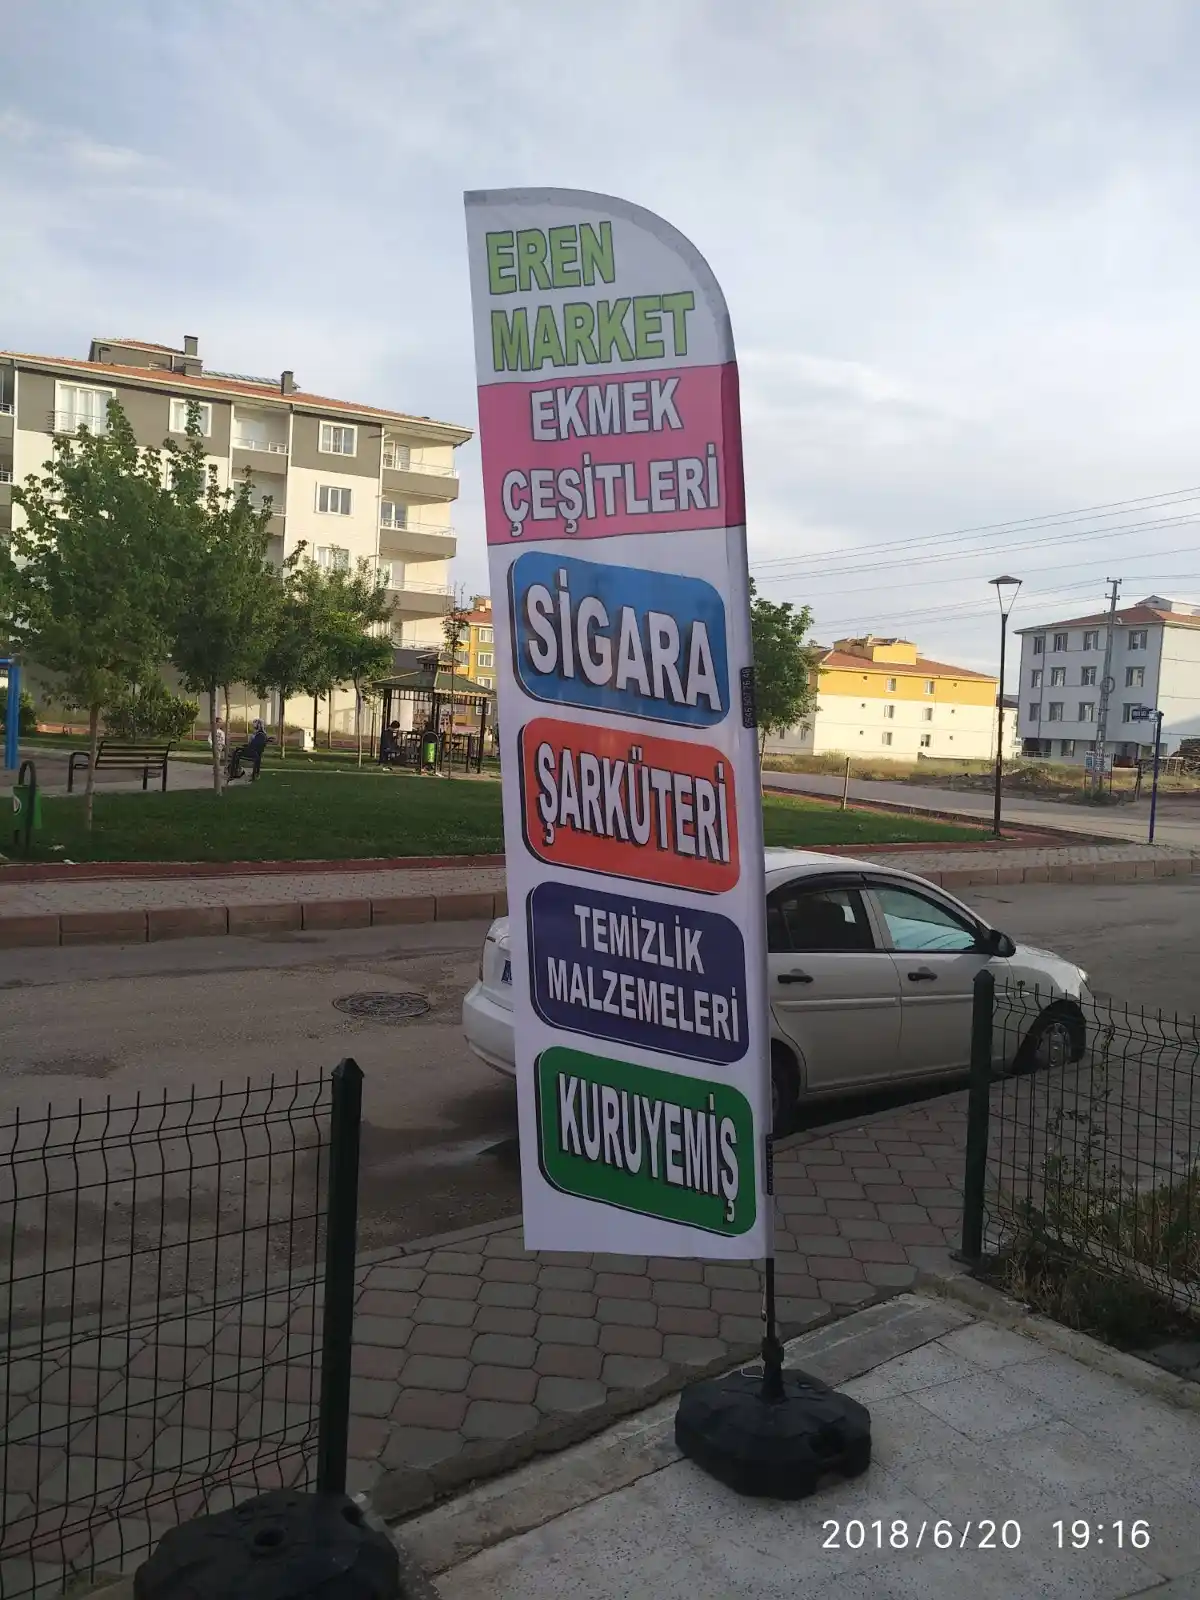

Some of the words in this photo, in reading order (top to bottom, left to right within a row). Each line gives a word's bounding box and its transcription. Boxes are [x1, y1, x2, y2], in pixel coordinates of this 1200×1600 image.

[485, 221, 616, 295] EREN
[490, 291, 695, 372] MARKET
[530, 377, 684, 441] EKMEK
[502, 442, 720, 537] ÇEŞİTLERİ
[525, 568, 723, 712] SİGARA
[536, 742, 731, 864] ŞARKÜTERİ
[574, 904, 705, 975] TEMİZLİK
[547, 956, 740, 1043] MALZEMELERİ
[557, 1072, 739, 1223] KURUYEMİŞ
